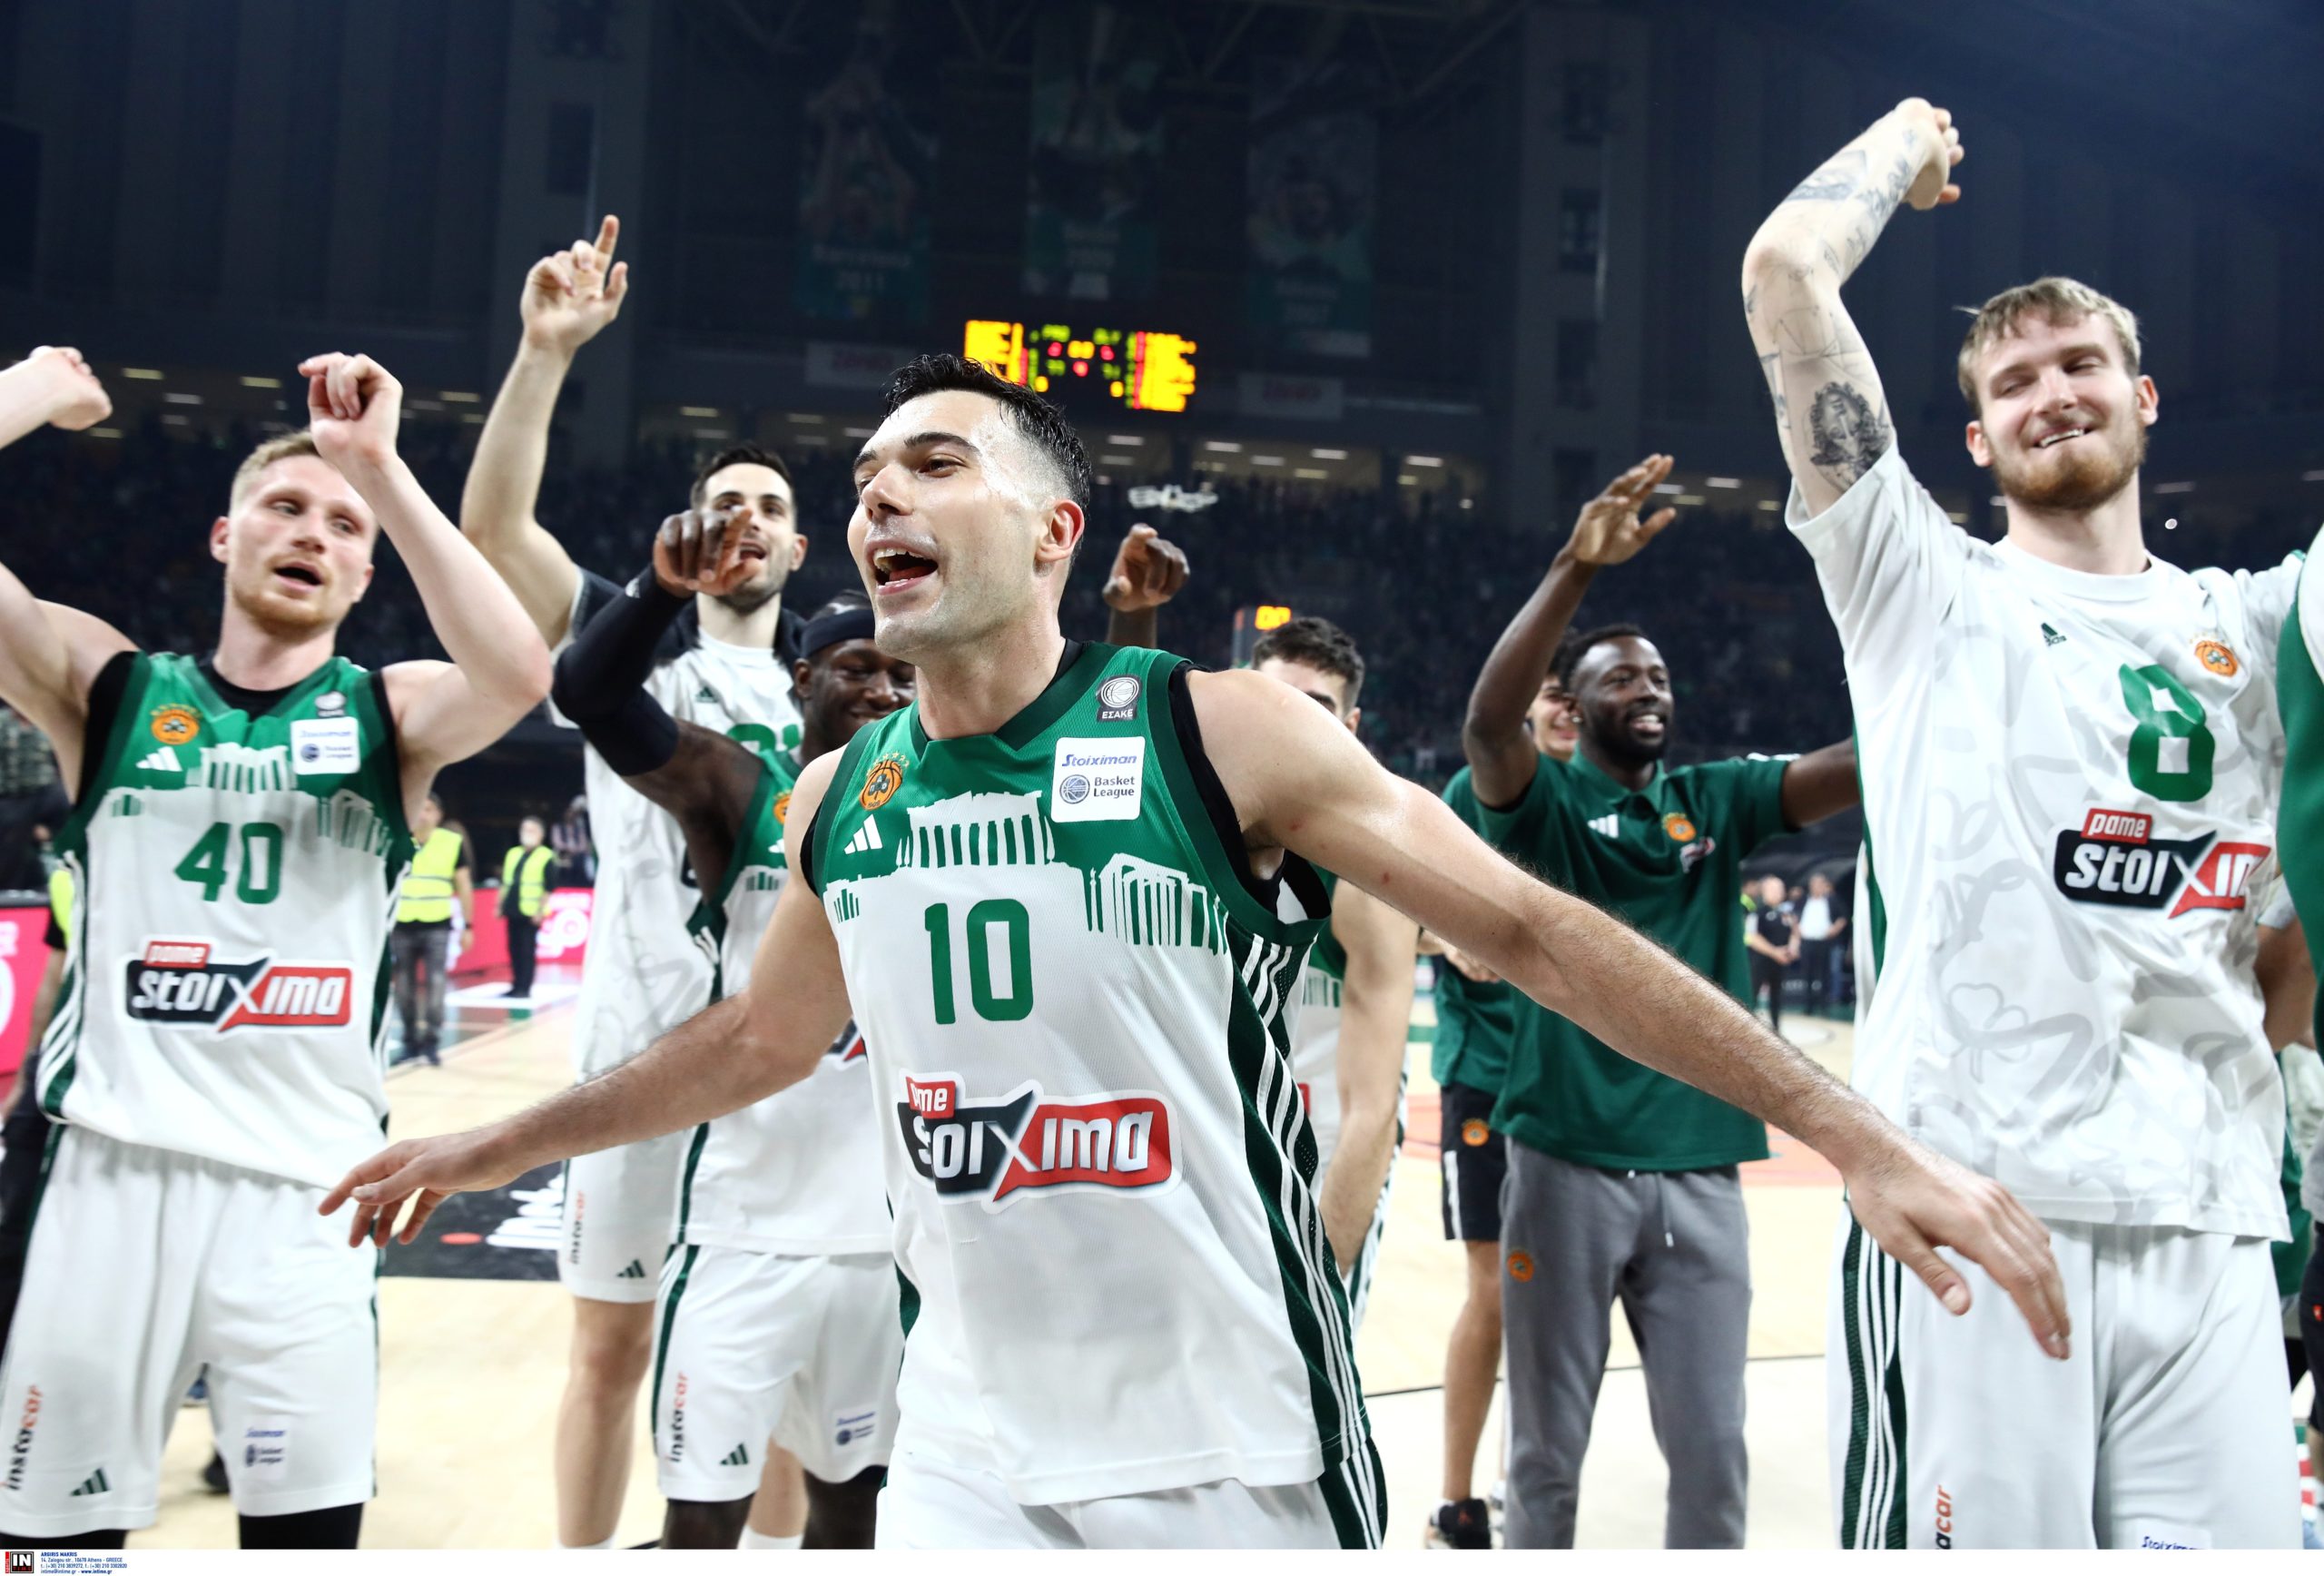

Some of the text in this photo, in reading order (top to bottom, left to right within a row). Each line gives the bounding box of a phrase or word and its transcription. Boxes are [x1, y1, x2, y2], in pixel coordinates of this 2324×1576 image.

[1101, 708, 1134, 719] ΕΣΑΚΕ
[2118, 663, 2216, 803] 8
[1061, 754, 1137, 767] Stoiximan
[1093, 787, 1135, 799] League
[1094, 775, 1136, 787] Basket
[2088, 813, 2147, 838] pame
[173, 821, 285, 904] 40
[924, 898, 1034, 1025] 10
[665, 1370, 688, 1463] instacar
